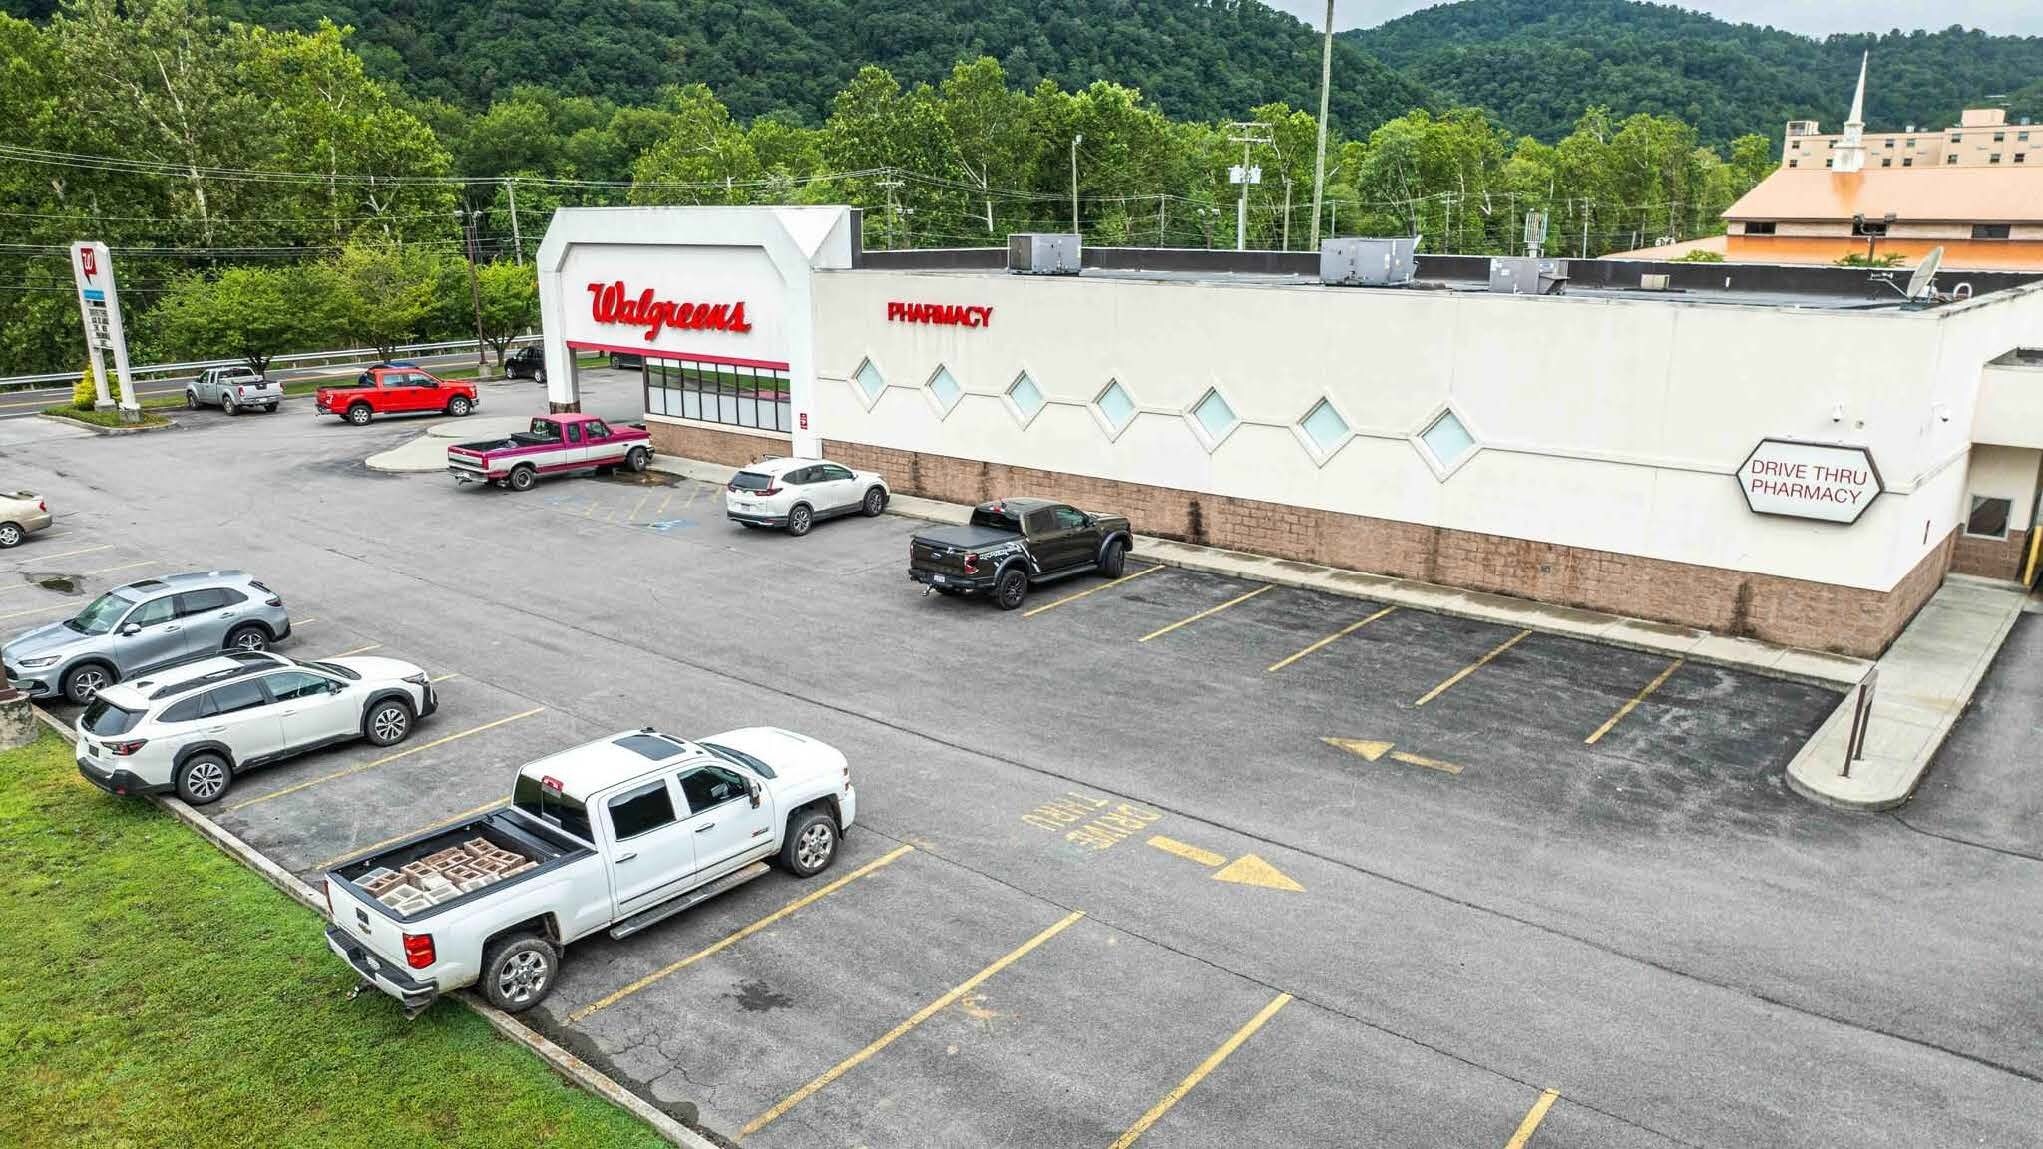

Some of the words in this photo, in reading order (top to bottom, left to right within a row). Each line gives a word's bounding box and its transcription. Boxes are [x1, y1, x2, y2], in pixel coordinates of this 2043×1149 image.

[588, 281, 751, 341] Walgreens
[888, 302, 993, 329] PHARMACY
[1751, 459, 1808, 480] DRIVE
[1813, 465, 1867, 486] THRU
[1751, 479, 1862, 504] PHARMACY
[1021, 792, 1109, 832] THRU
[1065, 803, 1163, 850] DRIVE
